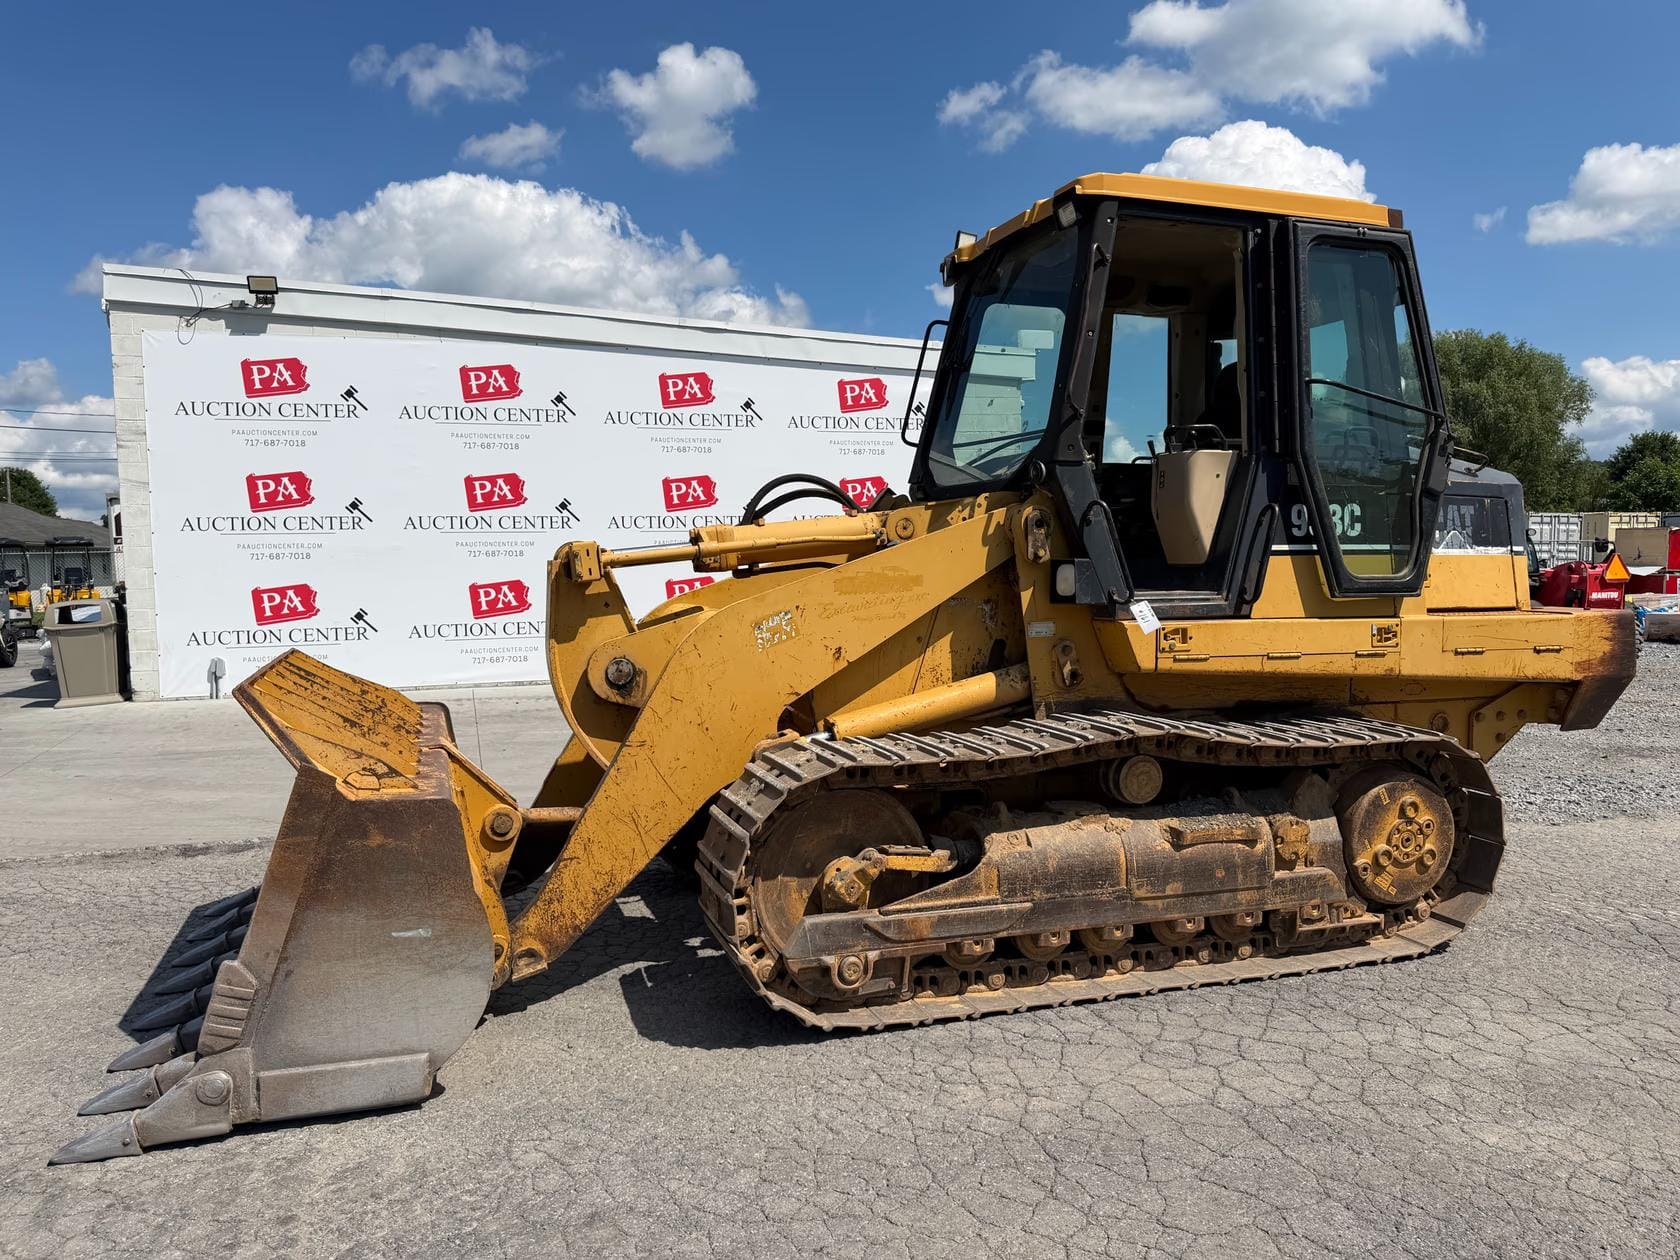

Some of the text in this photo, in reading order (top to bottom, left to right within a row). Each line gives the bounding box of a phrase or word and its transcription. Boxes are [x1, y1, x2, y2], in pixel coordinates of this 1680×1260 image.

[250, 363, 296, 389] PA
[467, 370, 510, 394] PA
[665, 377, 704, 401] PA
[844, 382, 878, 405] PA
[174, 400, 361, 419] AUCTION CENTER
[398, 406, 568, 424] AUCTION CENTER
[604, 411, 756, 428] AUCTION CENTER
[787, 416, 925, 431] AUCTION CENTER
[231, 429, 318, 437] PAAUCTIONCENTER.COM
[450, 432, 531, 440] PAAUCTIONCENTER.COM
[244, 439, 306, 447] 717-687-7018
[462, 442, 520, 450] 717-687-7018
[660, 446, 712, 454] 717-687-7018
[839, 448, 886, 456] 717-687-7018
[255, 476, 301, 503] PA
[472, 477, 514, 502] PA
[669, 479, 708, 504] PA
[846, 480, 879, 503] PA
[180, 514, 365, 532] AUCTION CENTER
[403, 515, 572, 531] AUCTION CENTER
[607, 515, 745, 530] AUCTION CENT
[1291, 503, 1362, 537] 93C
[1438, 504, 1475, 548] AT
[236, 542, 323, 550] PAAUCTIONCENTER.COM
[455, 540, 535, 548] PAAUCTIONCENTER.COM
[249, 552, 311, 560] 717-687-7018
[467, 549, 525, 558] 717-687-7018
[260, 588, 306, 616] PA
[477, 584, 519, 610] PA
[1591, 591, 1619, 599] MANITOU
[186, 626, 371, 647] AUCTION CENTER
[408, 620, 546, 639] AUCTION CEN
[460, 646, 539, 654] PAAUCTIONCENTER.COM
[471, 655, 529, 664] 717-687-7018
